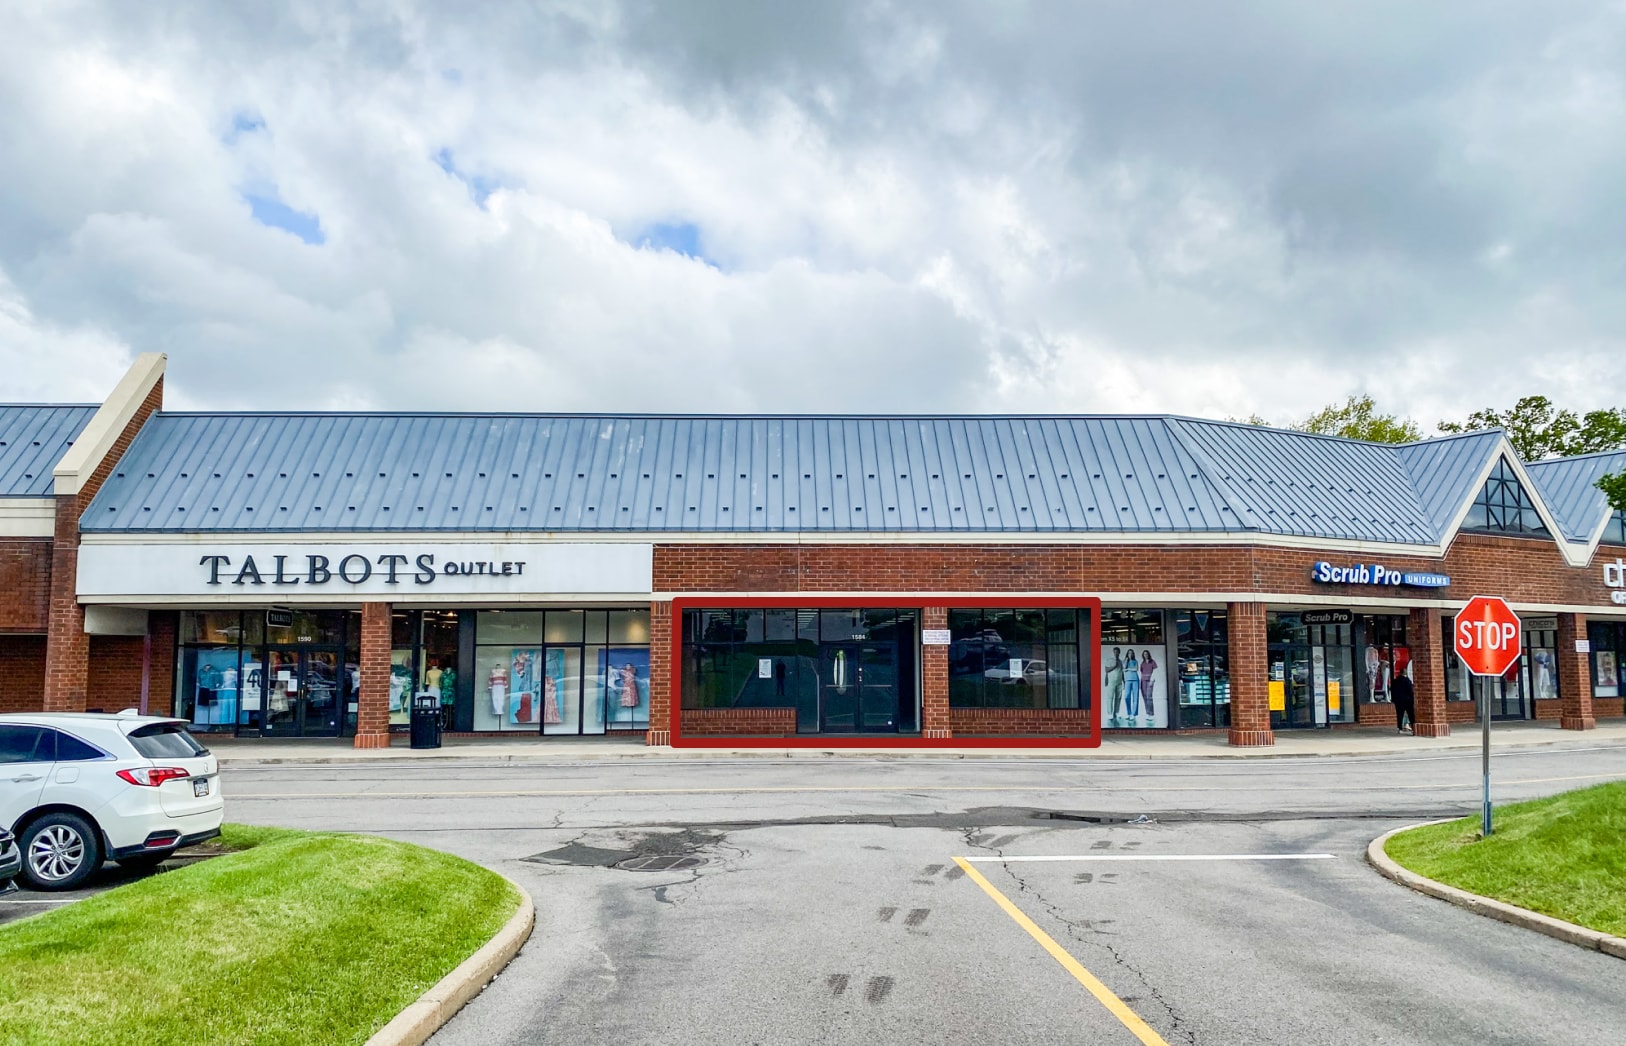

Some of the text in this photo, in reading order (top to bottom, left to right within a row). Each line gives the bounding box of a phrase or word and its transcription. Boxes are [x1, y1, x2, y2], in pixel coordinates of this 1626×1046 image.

[200, 554, 526, 585] TALBOTS OUTLET
[1316, 561, 1447, 586] Scrub Pro UNIFORMS
[1305, 612, 1348, 622] Scrub Pro
[1459, 620, 1516, 651] STOP
